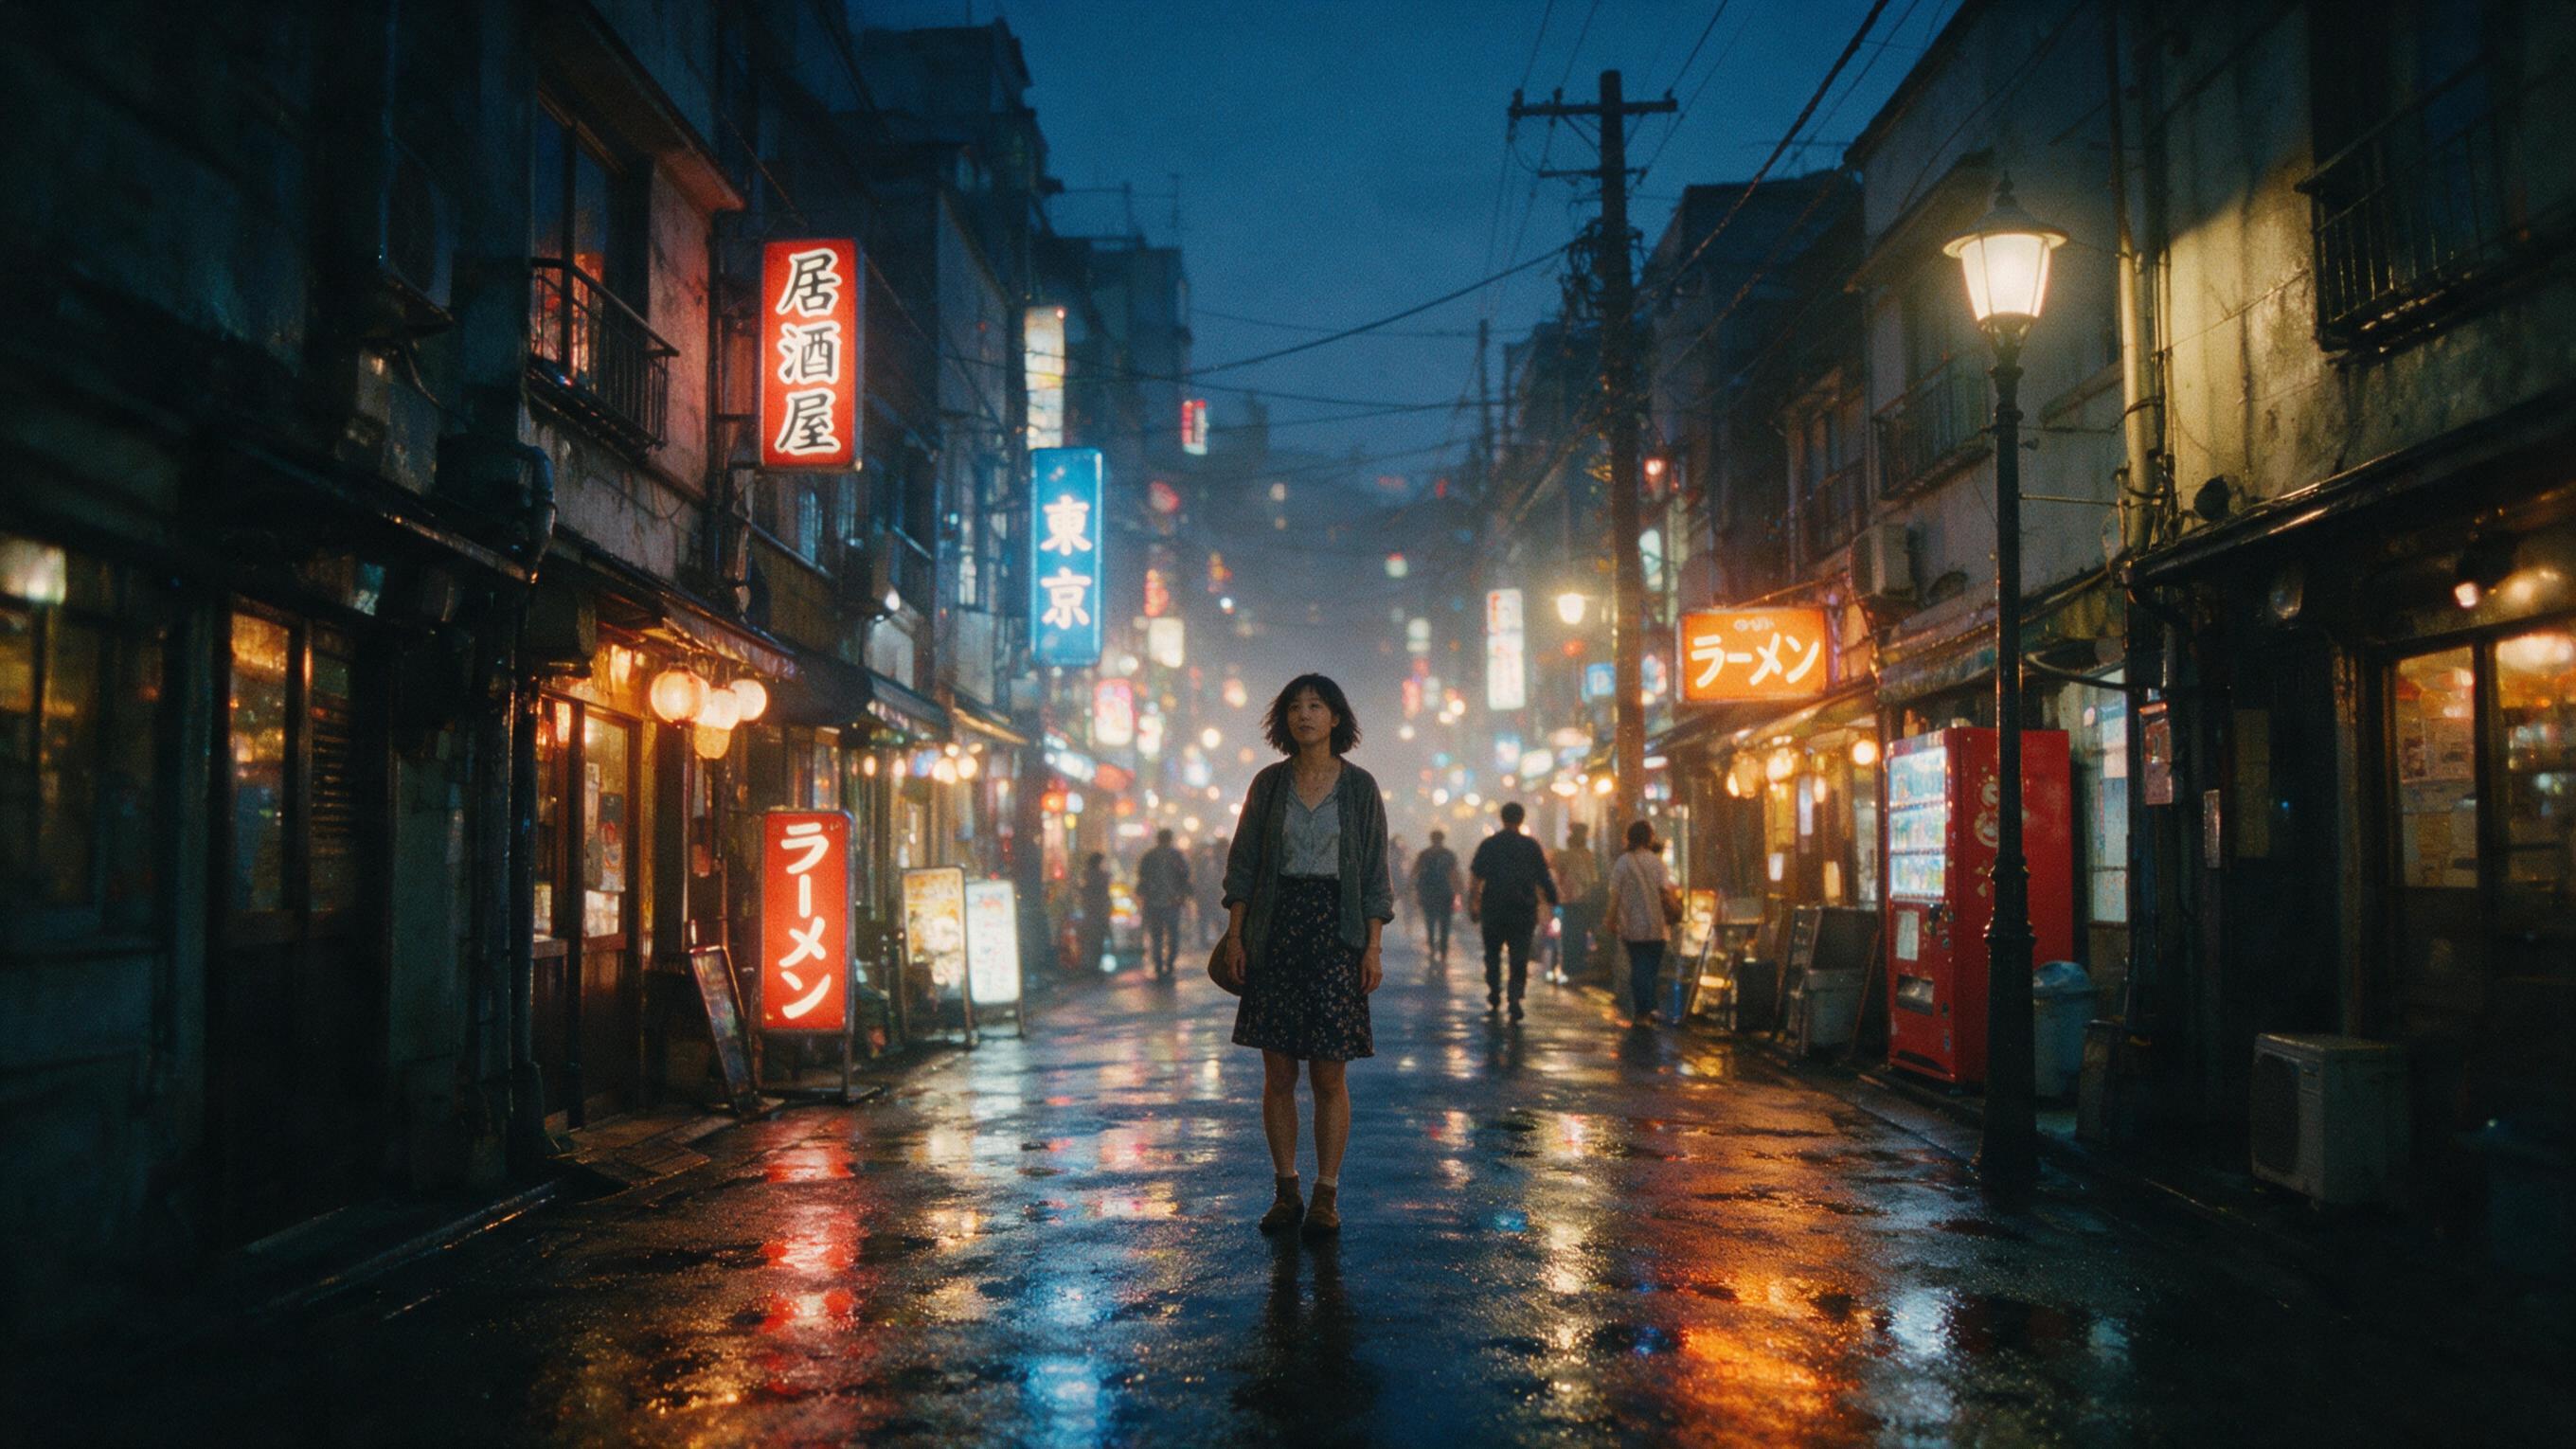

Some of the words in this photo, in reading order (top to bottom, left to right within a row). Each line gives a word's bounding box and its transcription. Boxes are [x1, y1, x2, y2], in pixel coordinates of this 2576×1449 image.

[776, 249, 841, 454] 居酒屋
[1040, 495, 1092, 629] 東京
[1690, 632, 1819, 688] ラーメン
[778, 822, 832, 1020] ラーメン
